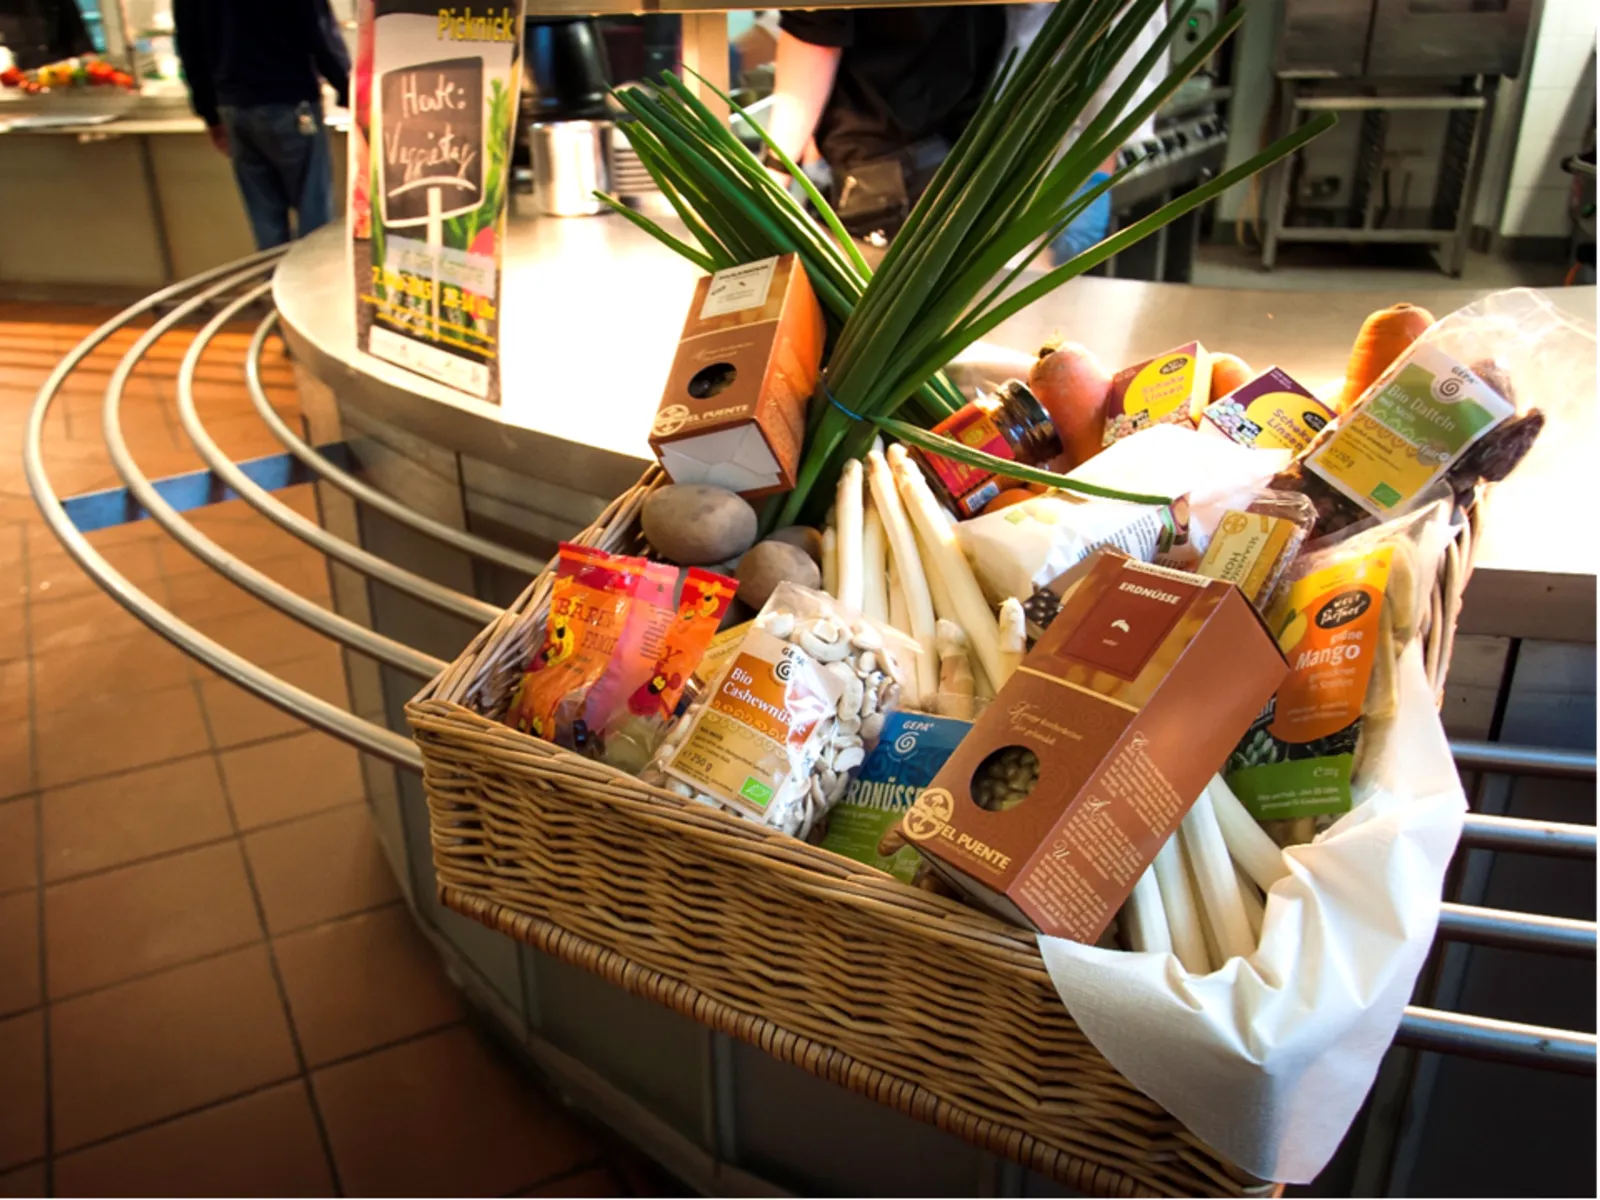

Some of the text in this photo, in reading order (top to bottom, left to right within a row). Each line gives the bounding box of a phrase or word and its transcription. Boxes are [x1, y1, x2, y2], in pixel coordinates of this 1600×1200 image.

[437, 8, 514, 41] Picknick
[1387, 384, 1456, 432] Bio Datteln
[1118, 582, 1182, 605] ERDNÜSSE
[1295, 644, 1361, 671] Mango
[731, 667, 753, 686] Bio
[902, 720, 931, 733] GEPA
[940, 825, 957, 841] EL
[956, 832, 1013, 870] PUENTE
